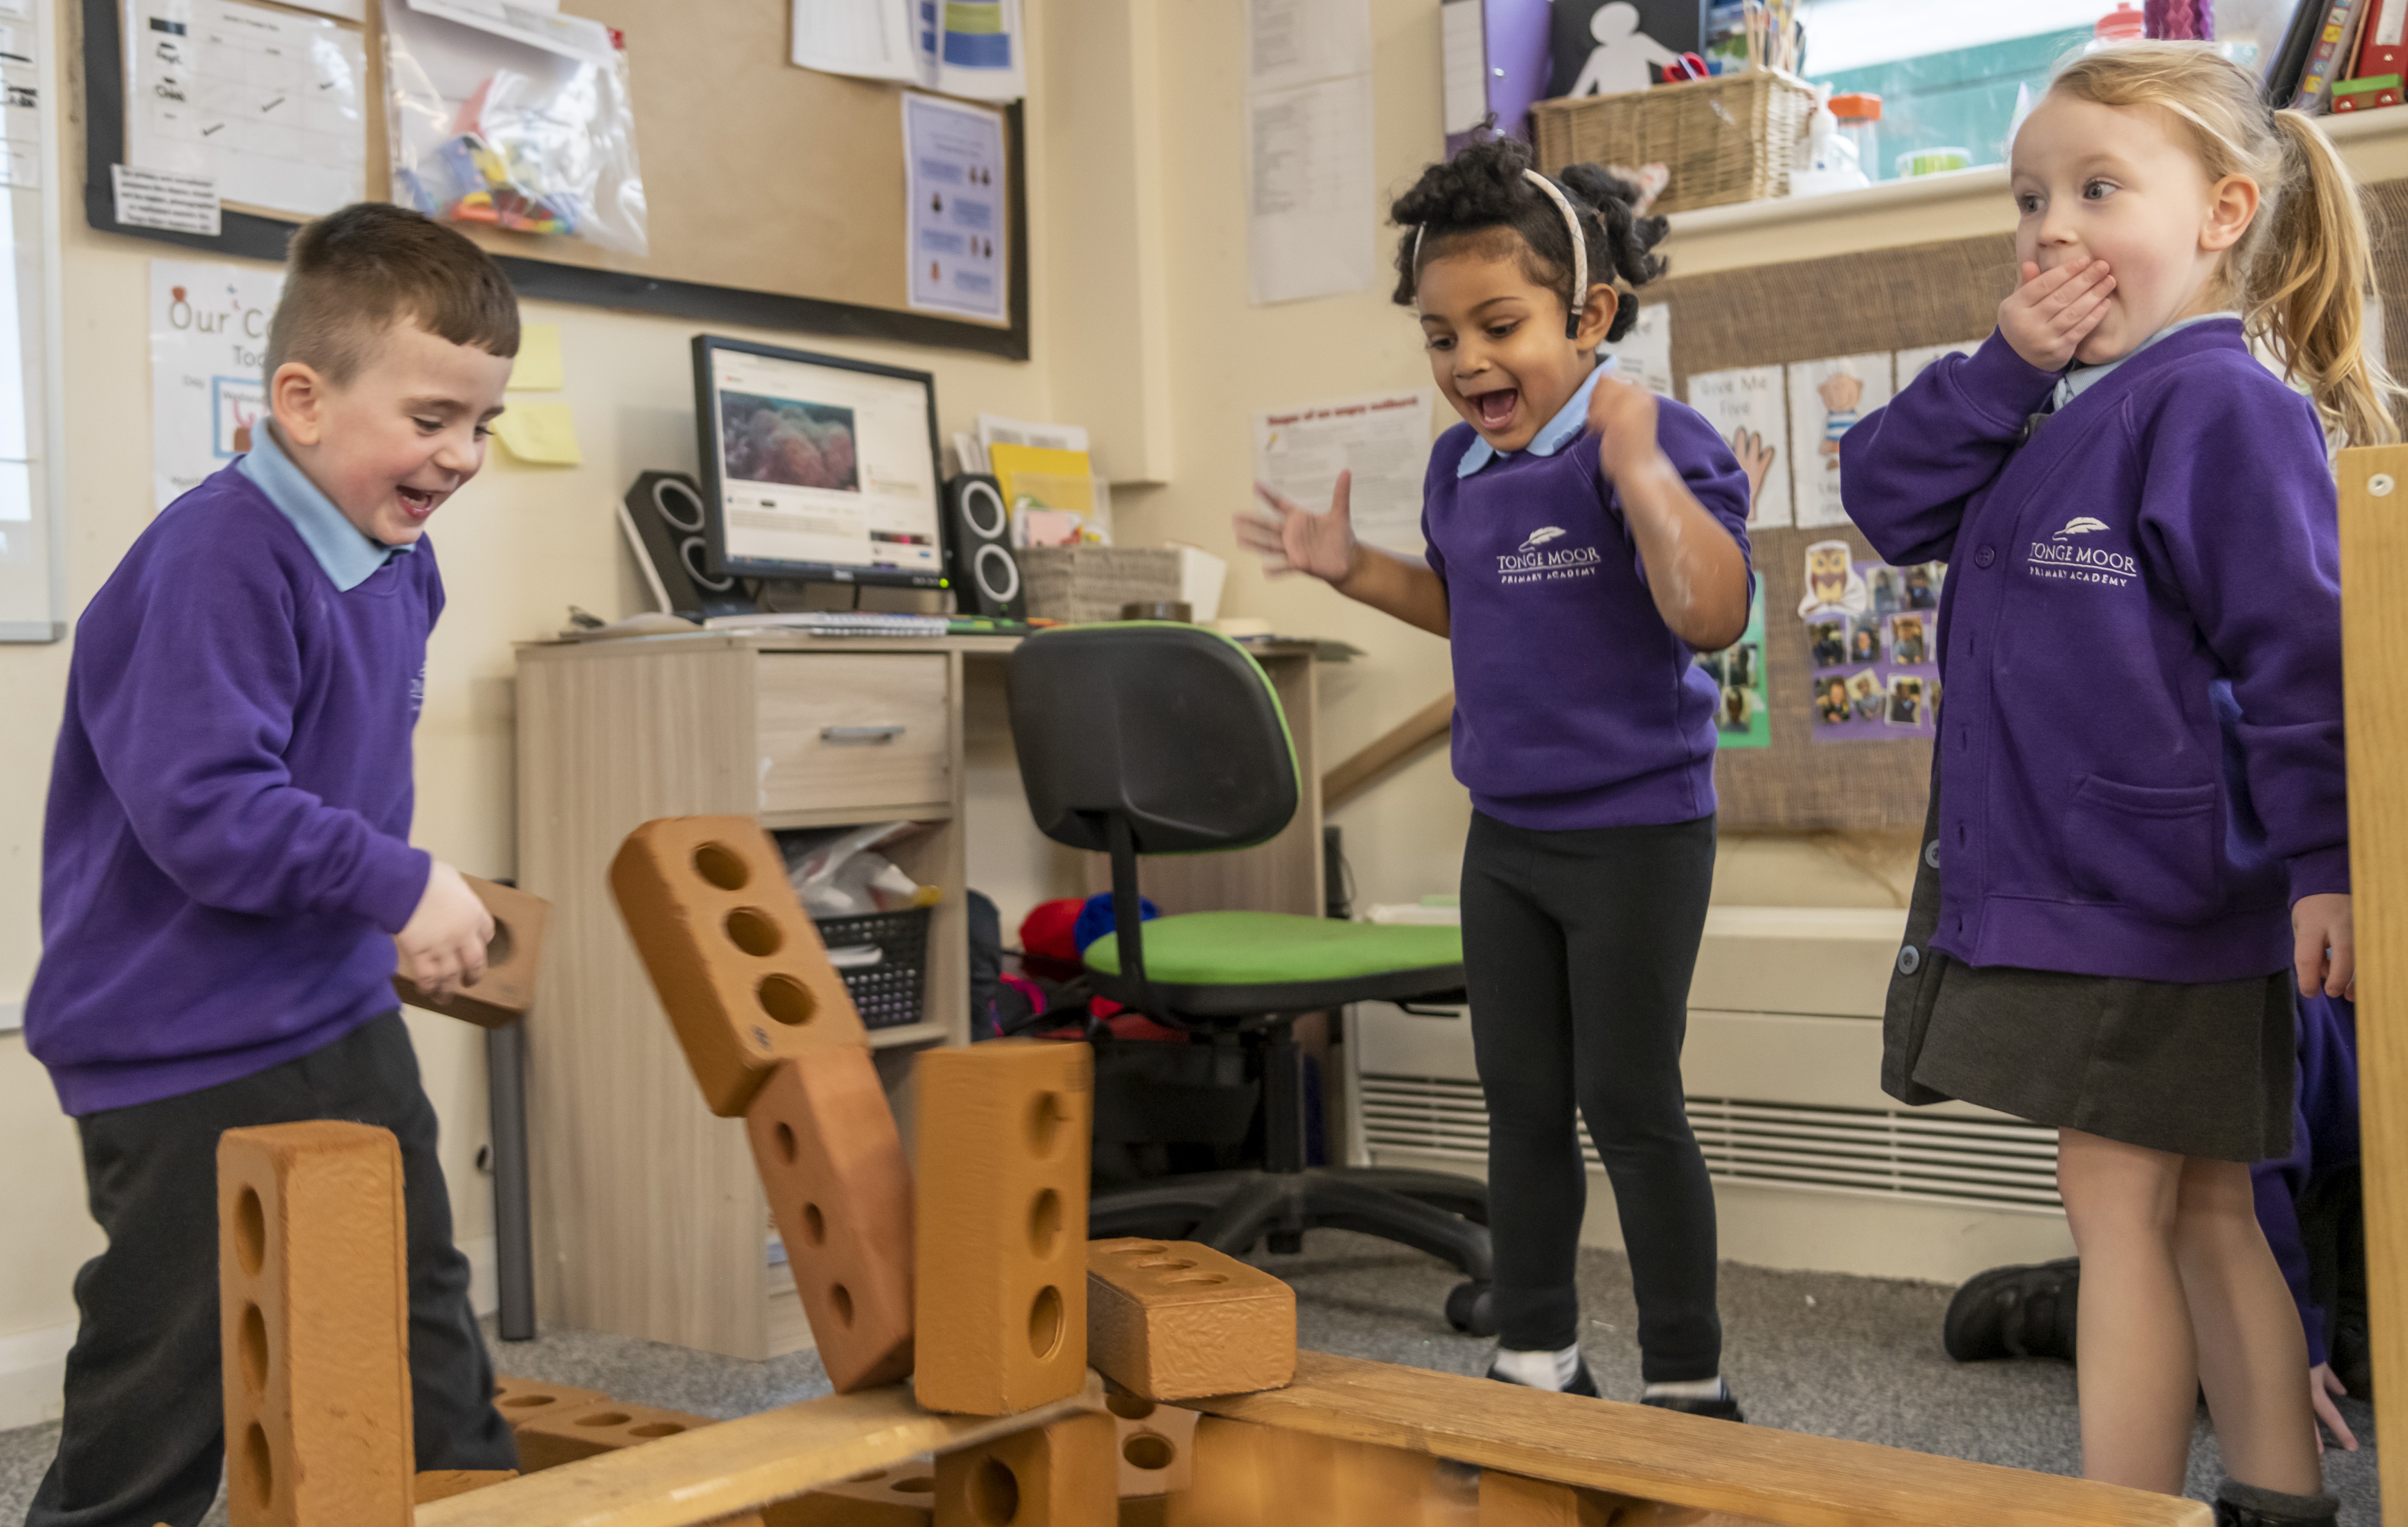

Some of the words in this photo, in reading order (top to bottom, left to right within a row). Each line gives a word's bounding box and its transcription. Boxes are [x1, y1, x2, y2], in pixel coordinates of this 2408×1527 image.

[169, 300, 230, 333] Our
[1700, 378, 1733, 395] Give
[1741, 375, 1767, 392] Me
[1719, 400, 1751, 416] Five
[1496, 552, 1544, 570] TONGE
[1548, 546, 1600, 565] MOOR
[2030, 542, 2073, 561] TONGE
[2076, 546, 2136, 573] MOOR
[1501, 573, 1542, 584] PRIMARY
[1546, 566, 1595, 580] ACADEMY
[2030, 566, 2067, 579] PRIMARY
[2070, 571, 2127, 587] ACADEMY
